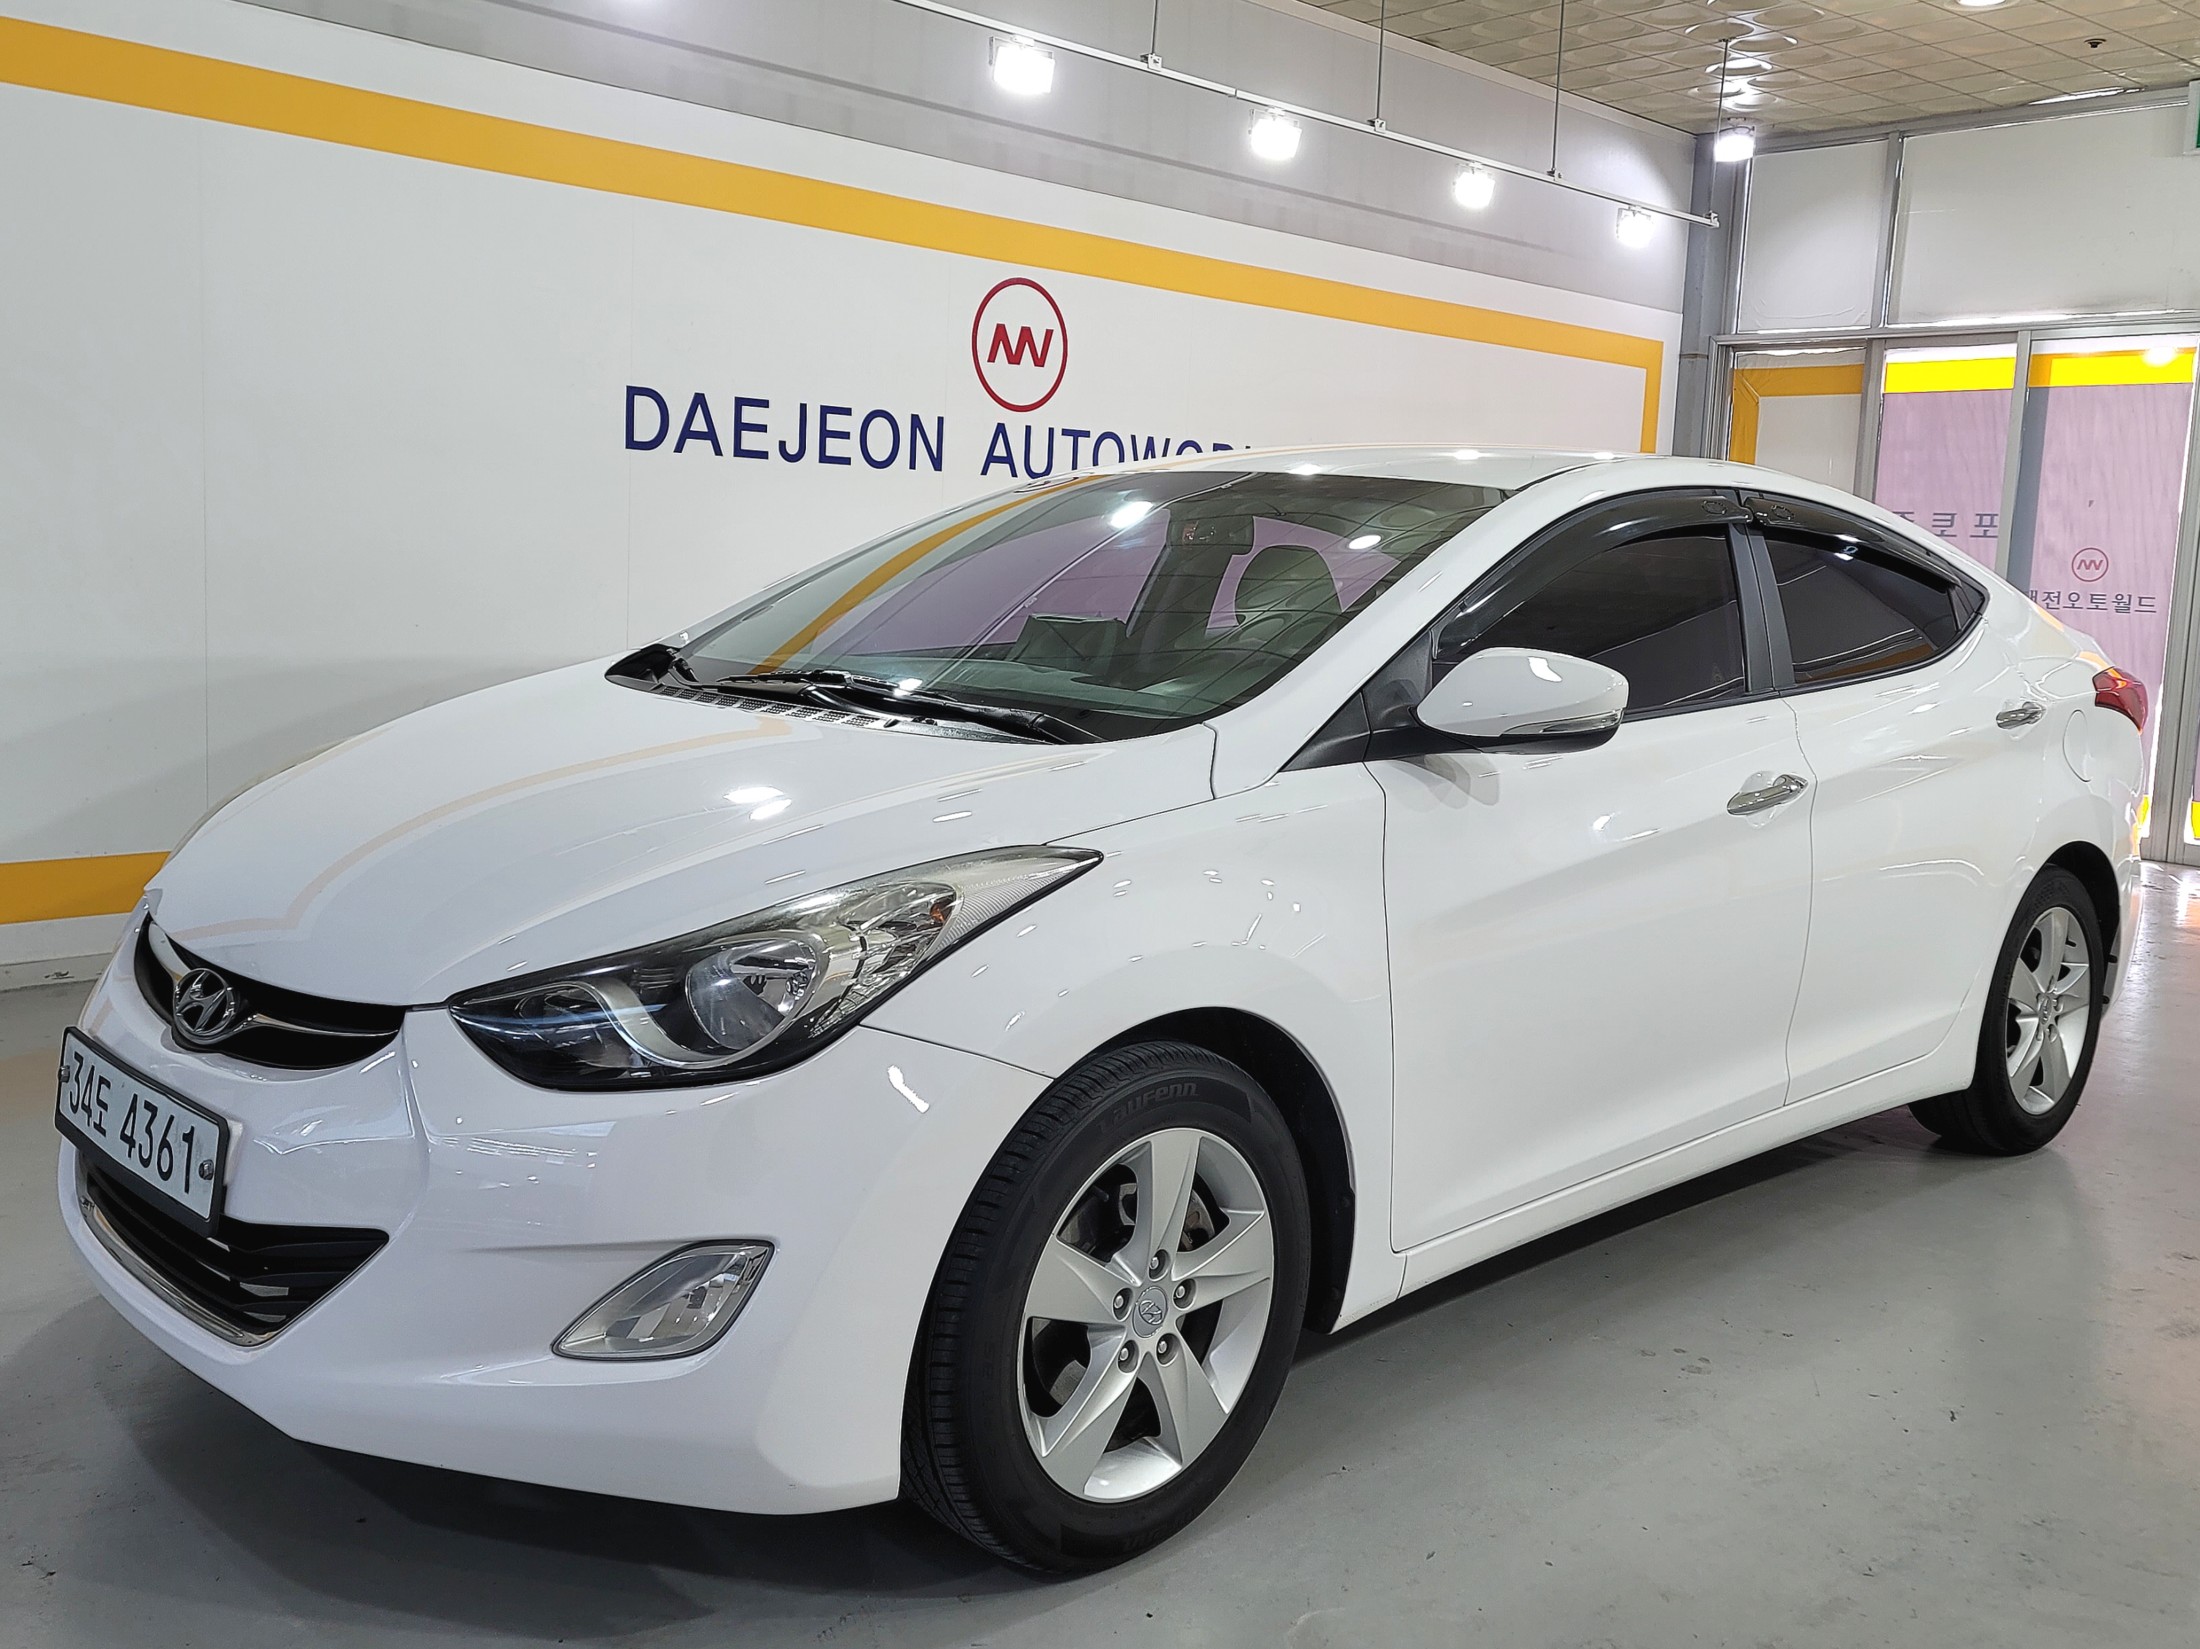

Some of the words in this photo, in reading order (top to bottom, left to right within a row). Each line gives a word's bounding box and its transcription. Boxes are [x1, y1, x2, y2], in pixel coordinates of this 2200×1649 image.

[625, 384, 944, 472] DAEJEON
[980, 422, 1251, 479] AUTOW
[69, 1051, 111, 1137] 34도
[120, 1093, 195, 1194] 4361
